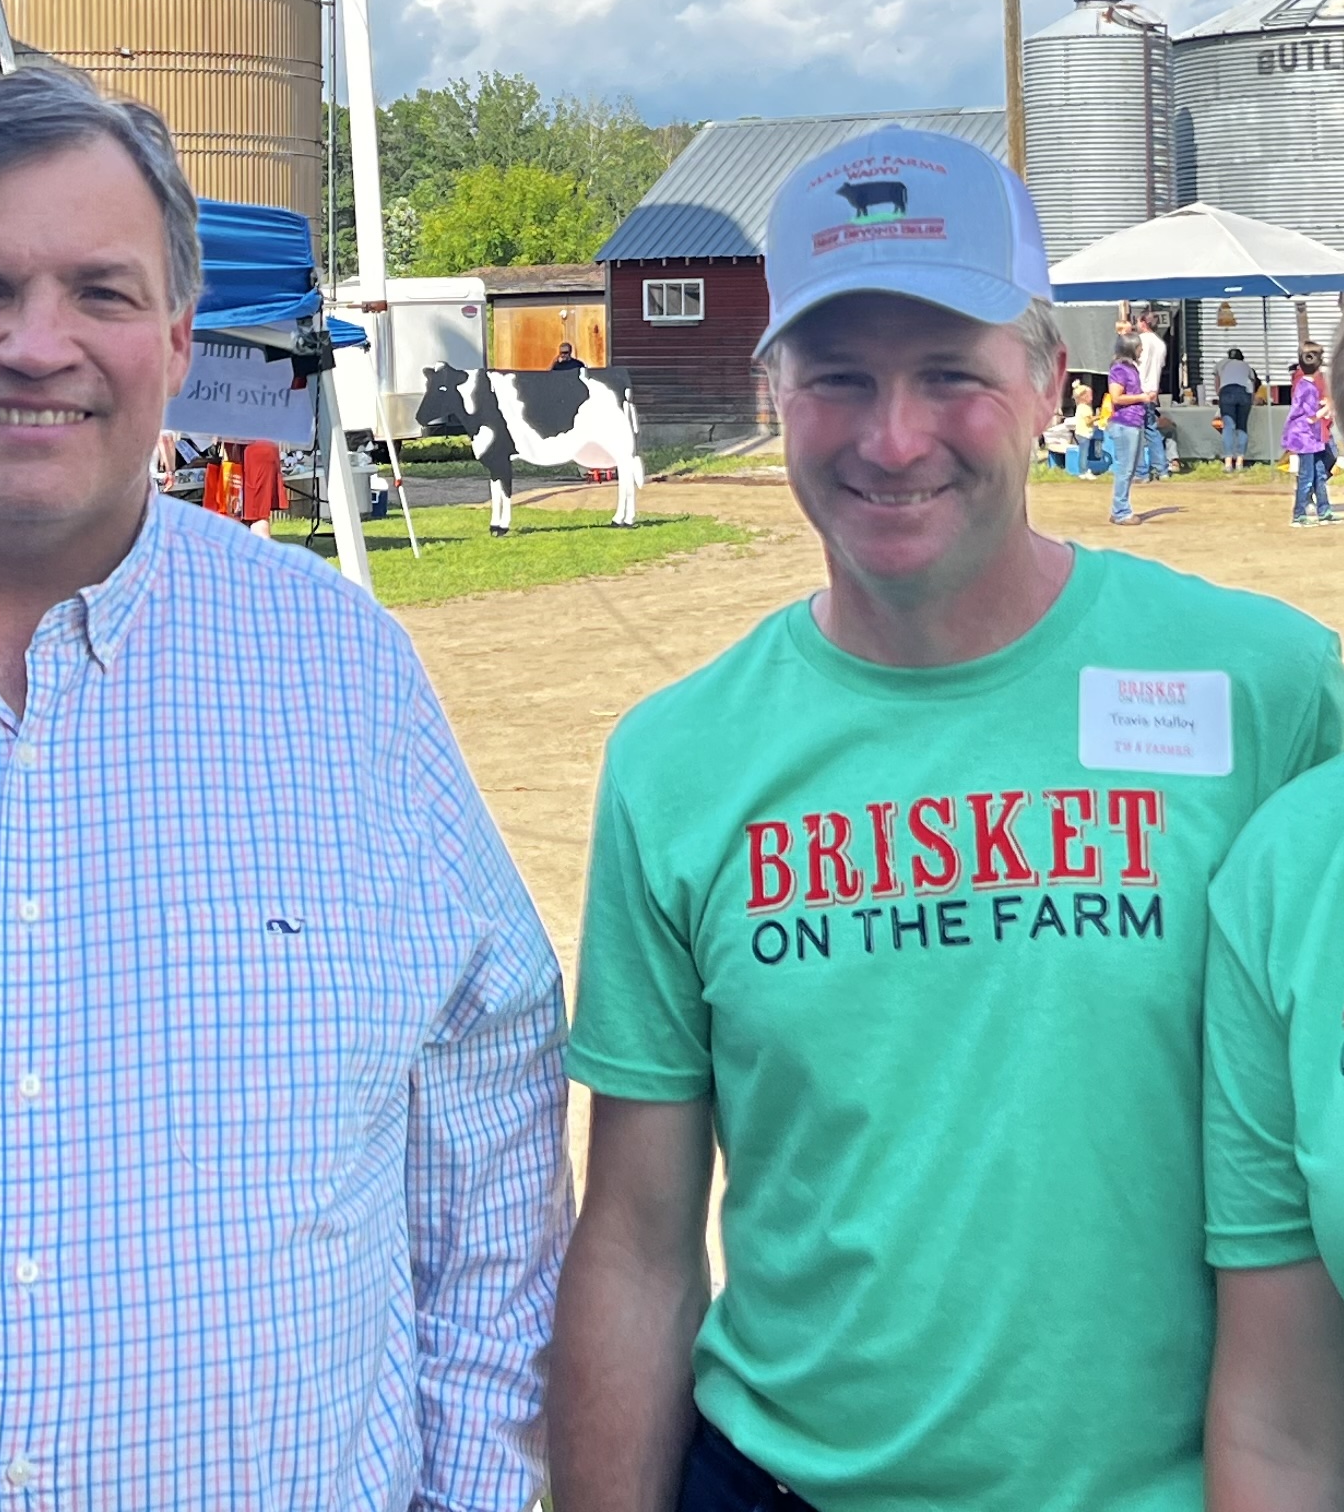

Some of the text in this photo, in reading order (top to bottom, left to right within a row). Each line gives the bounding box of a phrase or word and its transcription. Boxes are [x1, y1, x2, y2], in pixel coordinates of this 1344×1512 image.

[882, 156, 948, 176] FARMS
[1153, 715, 1195, 735] Malloy
[745, 787, 1164, 916] BRISKET
[751, 892, 1164, 965] ON THE FARM
